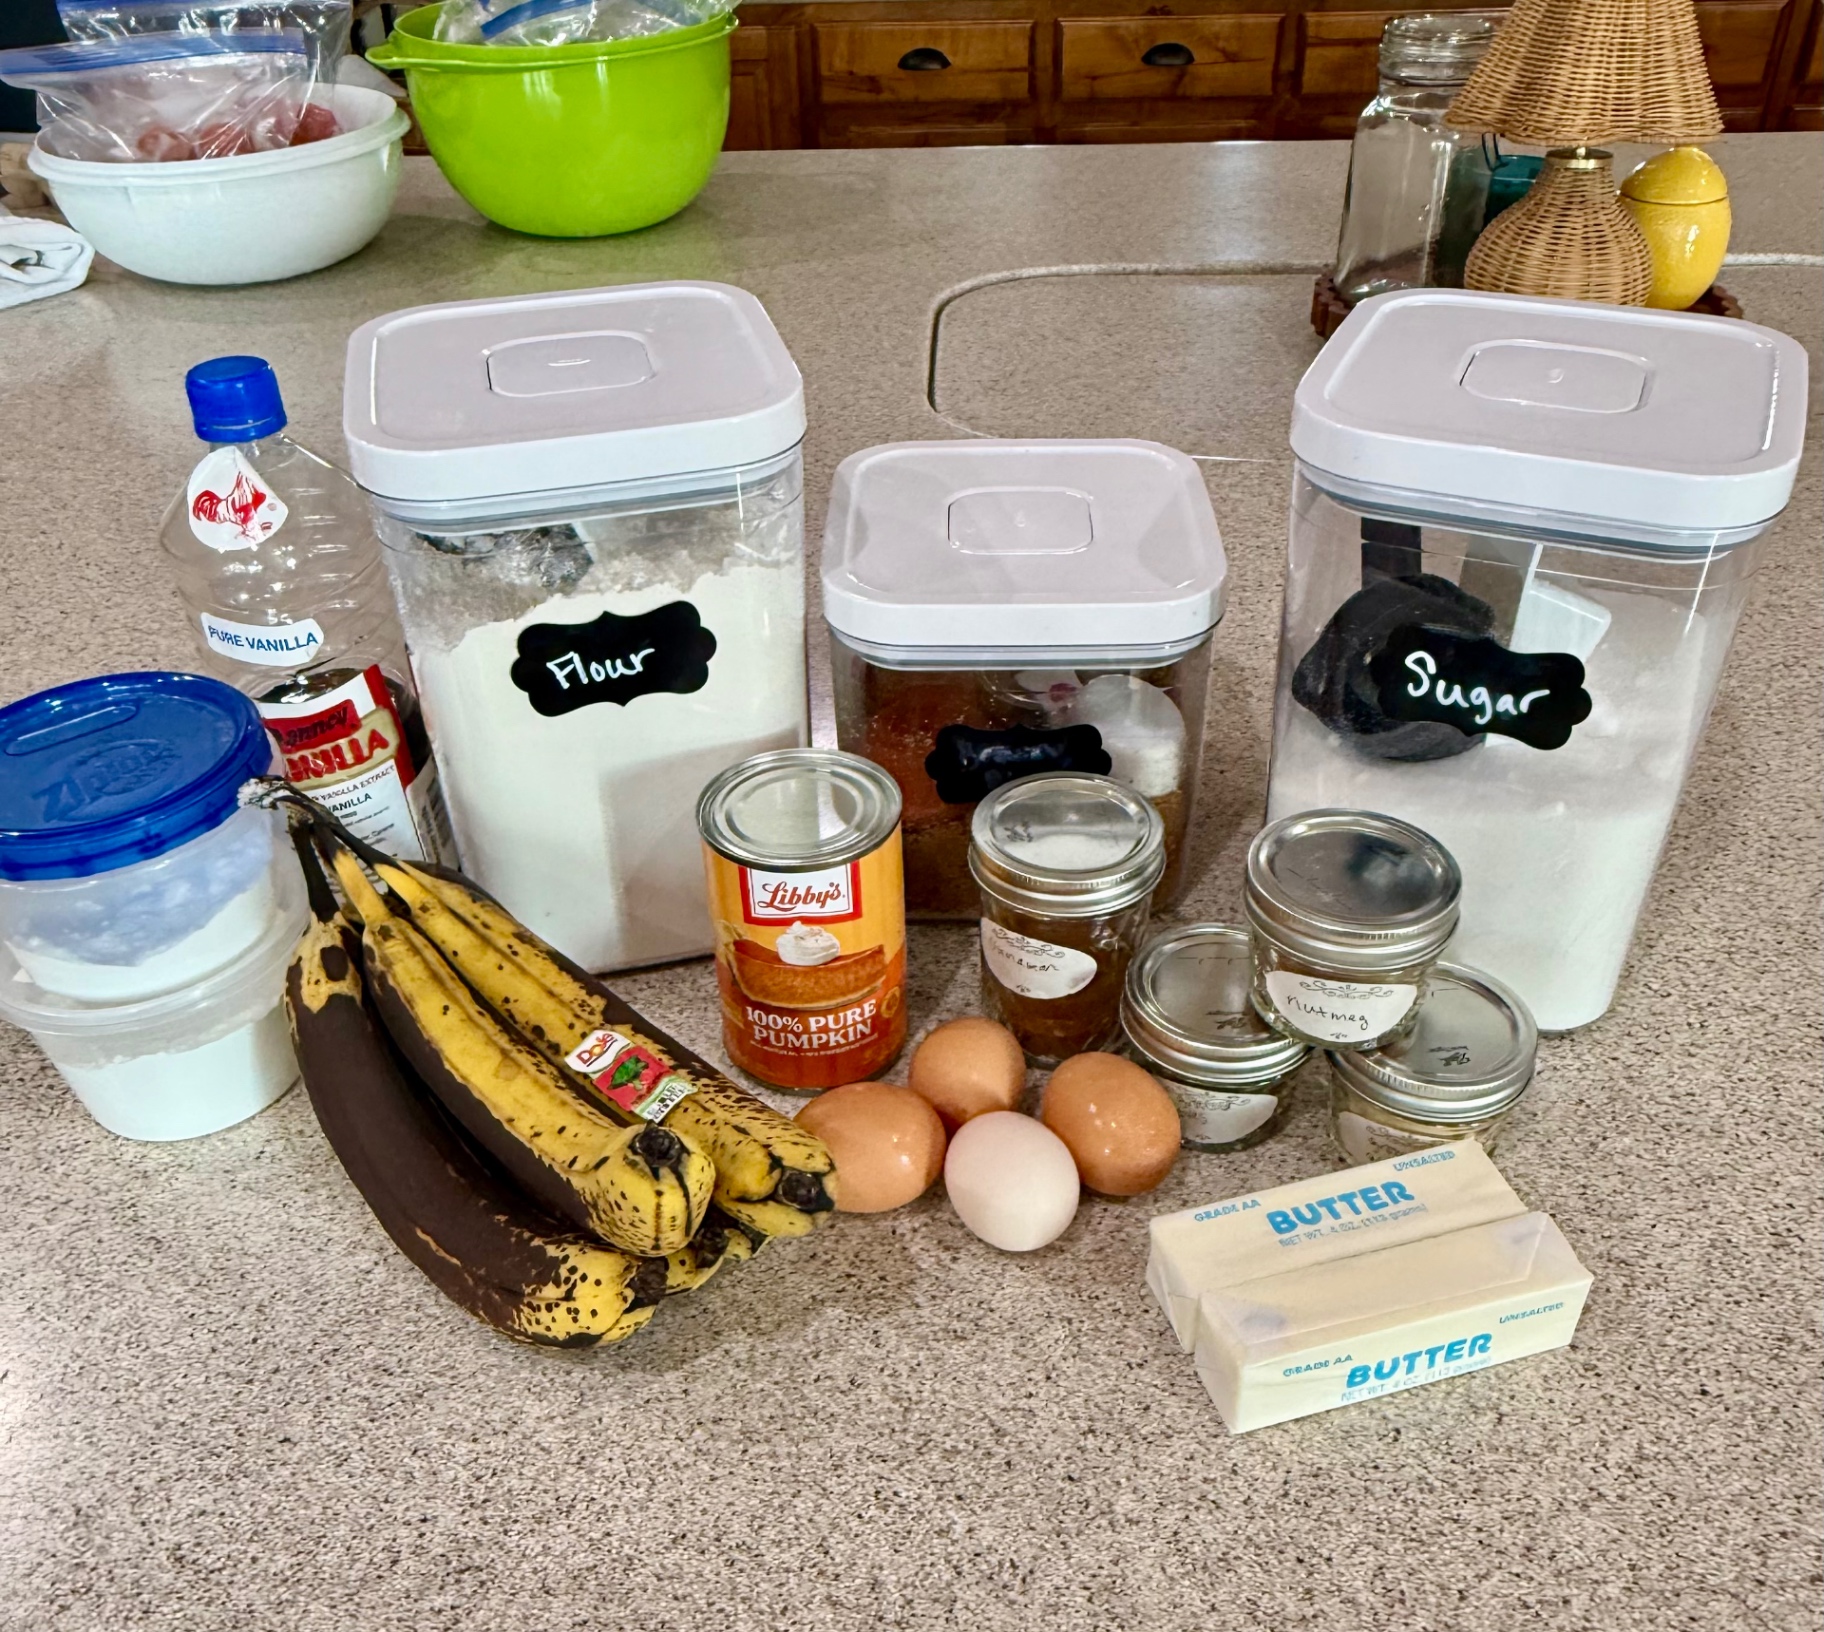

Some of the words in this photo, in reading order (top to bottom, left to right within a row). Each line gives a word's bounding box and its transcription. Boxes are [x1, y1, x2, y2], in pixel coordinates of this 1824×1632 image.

[208, 625, 244, 647] PURE
[246, 632, 319, 652] VANILLA
[546, 651, 655, 690] Flour
[1405, 650, 1550, 724] Sugar
[757, 881, 842, 913] Libby's
[746, 1006, 803, 1032] 100%
[808, 999, 877, 1032] PURE
[753, 1019, 872, 1049] PUMPKIN
[1194, 1204, 1240, 1222] GRADE
[1242, 1199, 1262, 1211] AA
[1266, 1181, 1416, 1235] BUTTER
[1283, 1360, 1330, 1377] GRADE
[1333, 1354, 1353, 1365] AA
[1346, 1333, 1493, 1389] BUTTER
